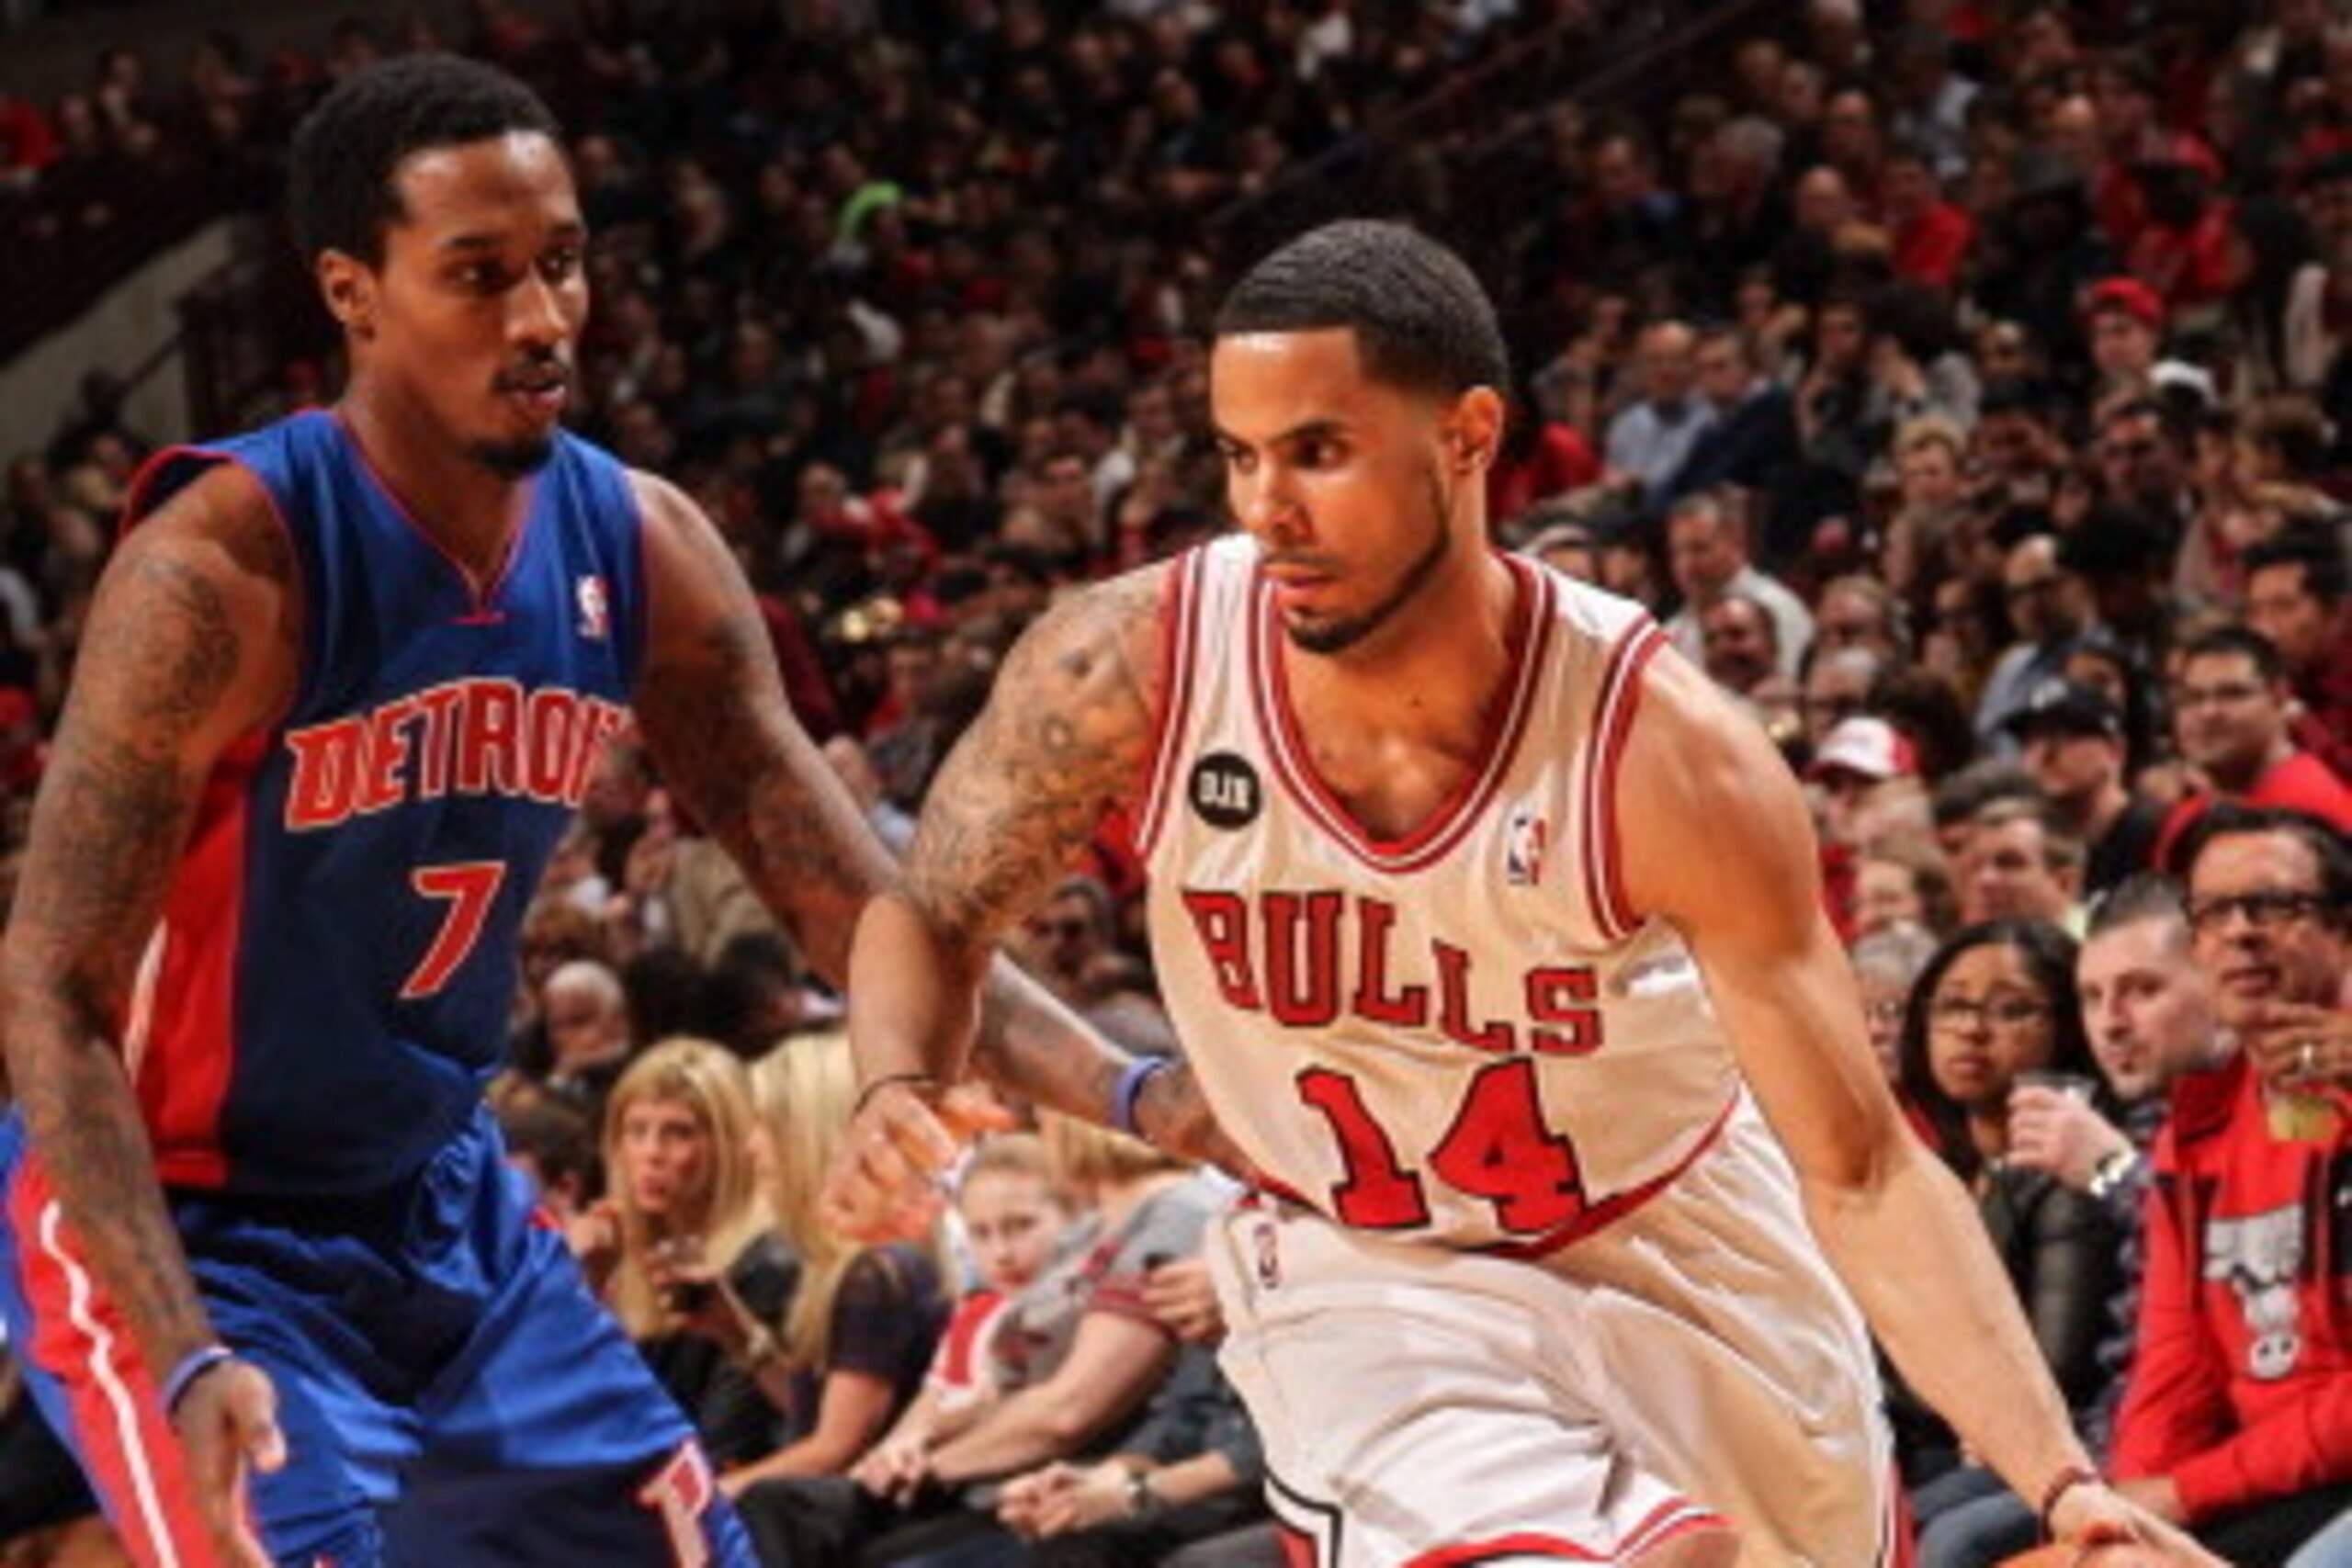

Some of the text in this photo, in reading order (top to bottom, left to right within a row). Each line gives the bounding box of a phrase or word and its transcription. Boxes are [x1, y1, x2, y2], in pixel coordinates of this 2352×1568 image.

[399, 861, 506, 998] 7
[1181, 888, 1602, 1055] BULLS
[1295, 1056, 1587, 1235] 14
